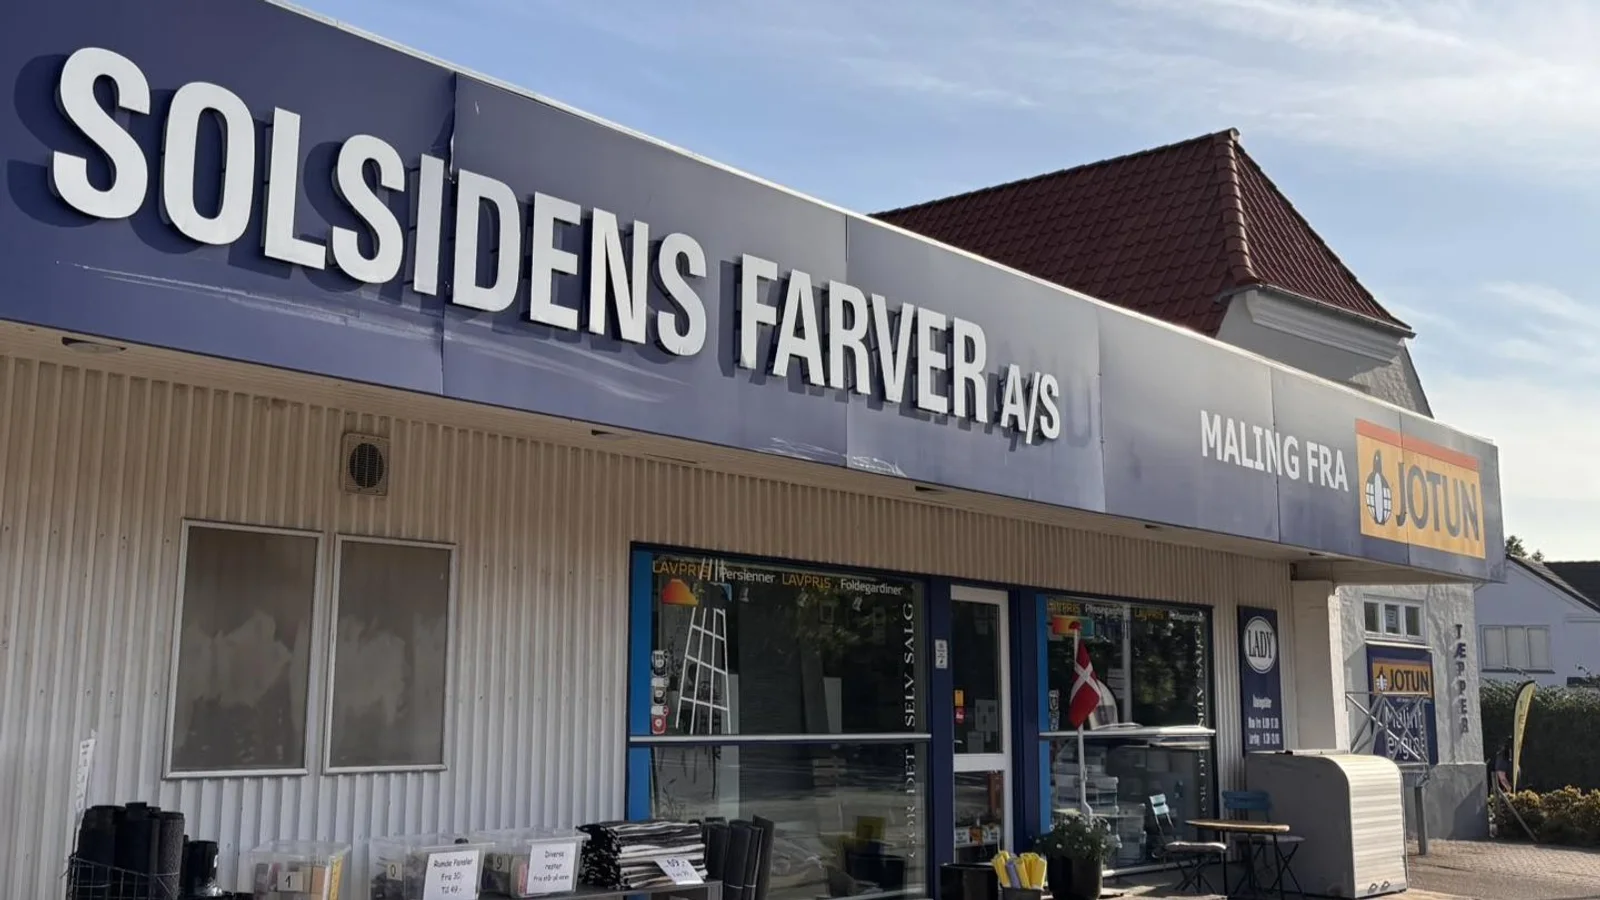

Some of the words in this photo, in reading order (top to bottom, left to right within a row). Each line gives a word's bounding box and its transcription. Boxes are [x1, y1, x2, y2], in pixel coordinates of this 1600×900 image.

[51, 46, 707, 357] SOLSIDENS
[739, 253, 988, 423] FARVER
[1000, 363, 1061, 445] A/S
[1200, 410, 1300, 480] MALING
[1306, 441, 1349, 492] FRA
[1395, 460, 1480, 541] JOTUN
[719, 566, 776, 583] Persienner
[782, 572, 832, 589] LAVPRIS
[841, 578, 904, 596] Foldegardiner
[902, 602, 915, 665] SALG
[1247, 629, 1273, 659] LADY
[903, 672, 916, 727] SELV
[1389, 668, 1429, 692] JOTUN
[1454, 624, 1469, 733] TÆPPER
[1385, 705, 1421, 729] Malin
[544, 850, 564, 858] Diverse
[441, 873, 452, 881] Fra
